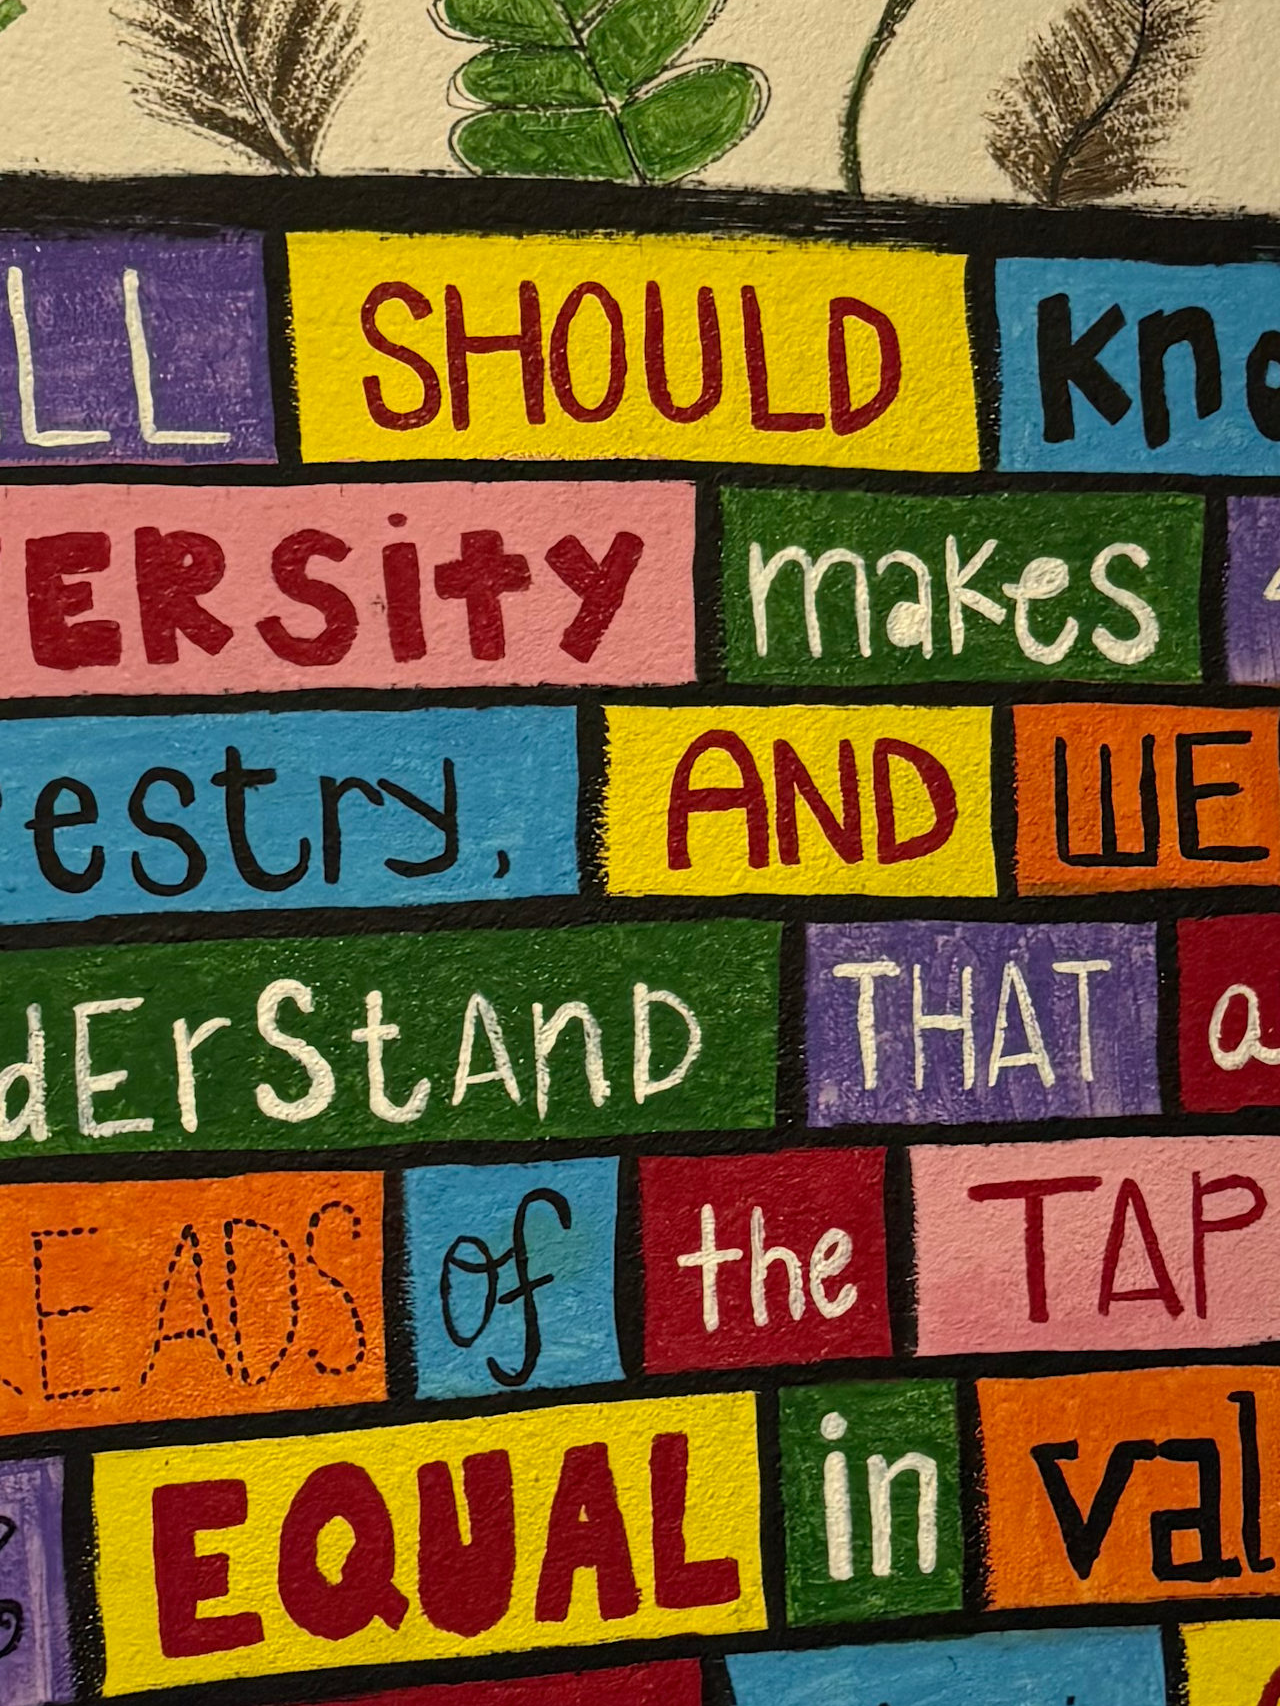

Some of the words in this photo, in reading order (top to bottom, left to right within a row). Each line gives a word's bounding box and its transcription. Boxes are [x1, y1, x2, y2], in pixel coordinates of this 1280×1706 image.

[361, 278, 901, 436] SHOULD
[747, 532, 1161, 668] makes
[664, 727, 961, 870] AND
[1055, 727, 1273, 870] WE
[830, 957, 1114, 1092] THAT
[438, 1185, 574, 1389] of
[676, 1201, 859, 1335] the
[149, 1431, 742, 1661] EQUAL
[819, 1410, 940, 1584] in
